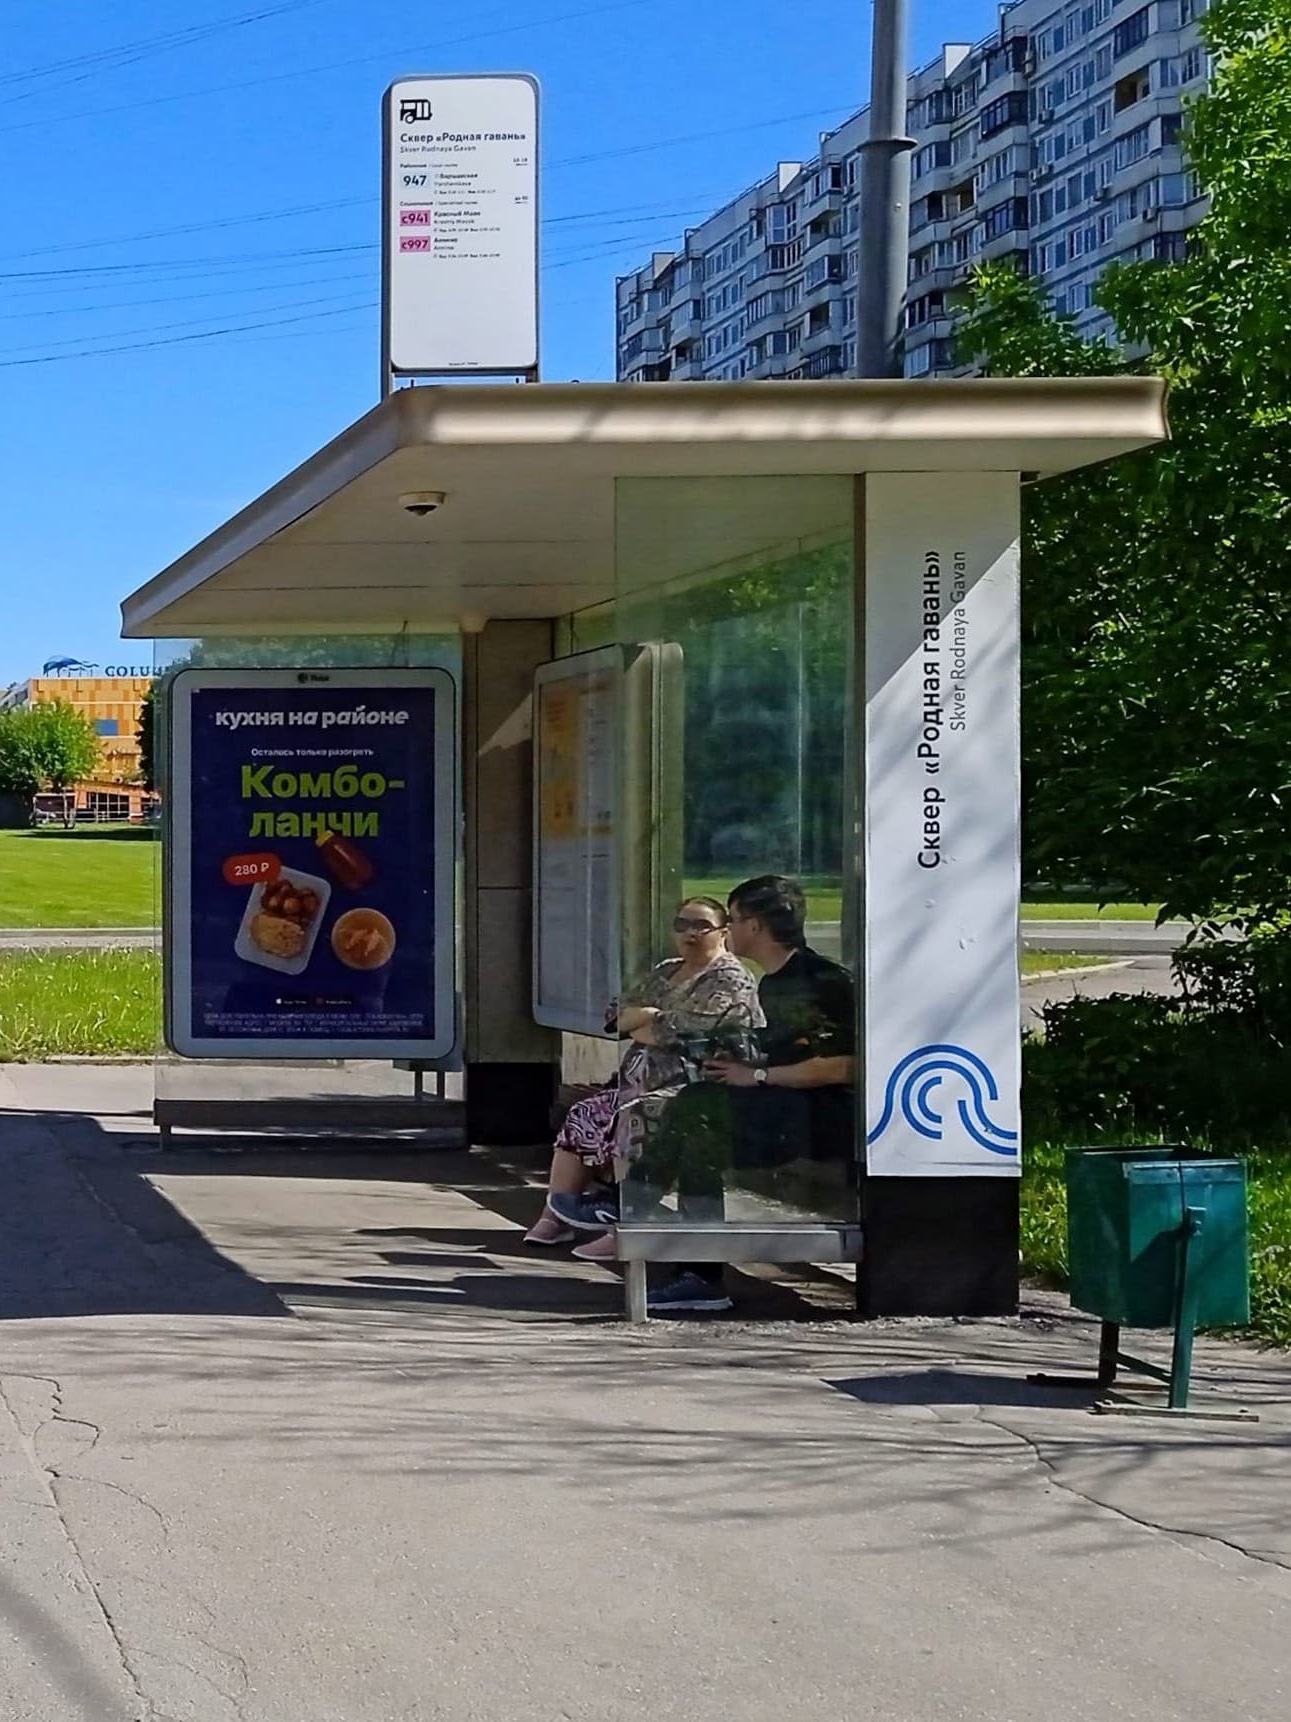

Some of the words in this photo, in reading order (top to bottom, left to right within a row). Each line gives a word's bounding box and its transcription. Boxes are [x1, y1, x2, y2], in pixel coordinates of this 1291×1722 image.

[400, 132, 434, 144] Сквер
[436, 131, 482, 142] «Родная
[484, 132, 526, 141] гавань»
[403, 174, 427, 187] 947
[950, 551, 966, 604] Gavan
[923, 550, 940, 652] гавань»
[949, 607, 969, 680] Rodnaya
[215, 711, 284, 730] кухня
[288, 711, 319, 726] на
[321, 704, 409, 729] районе
[917, 661, 943, 774] «Родная
[950, 682, 966, 731] Skver
[251, 748, 295, 757] Осталось
[296, 748, 328, 757] только
[328, 748, 375, 758] разогреть
[241, 765, 405, 798] Комбо-
[248, 811, 379, 838] ланчи
[917, 786, 945, 869] Сквер
[234, 863, 258, 877] 280
